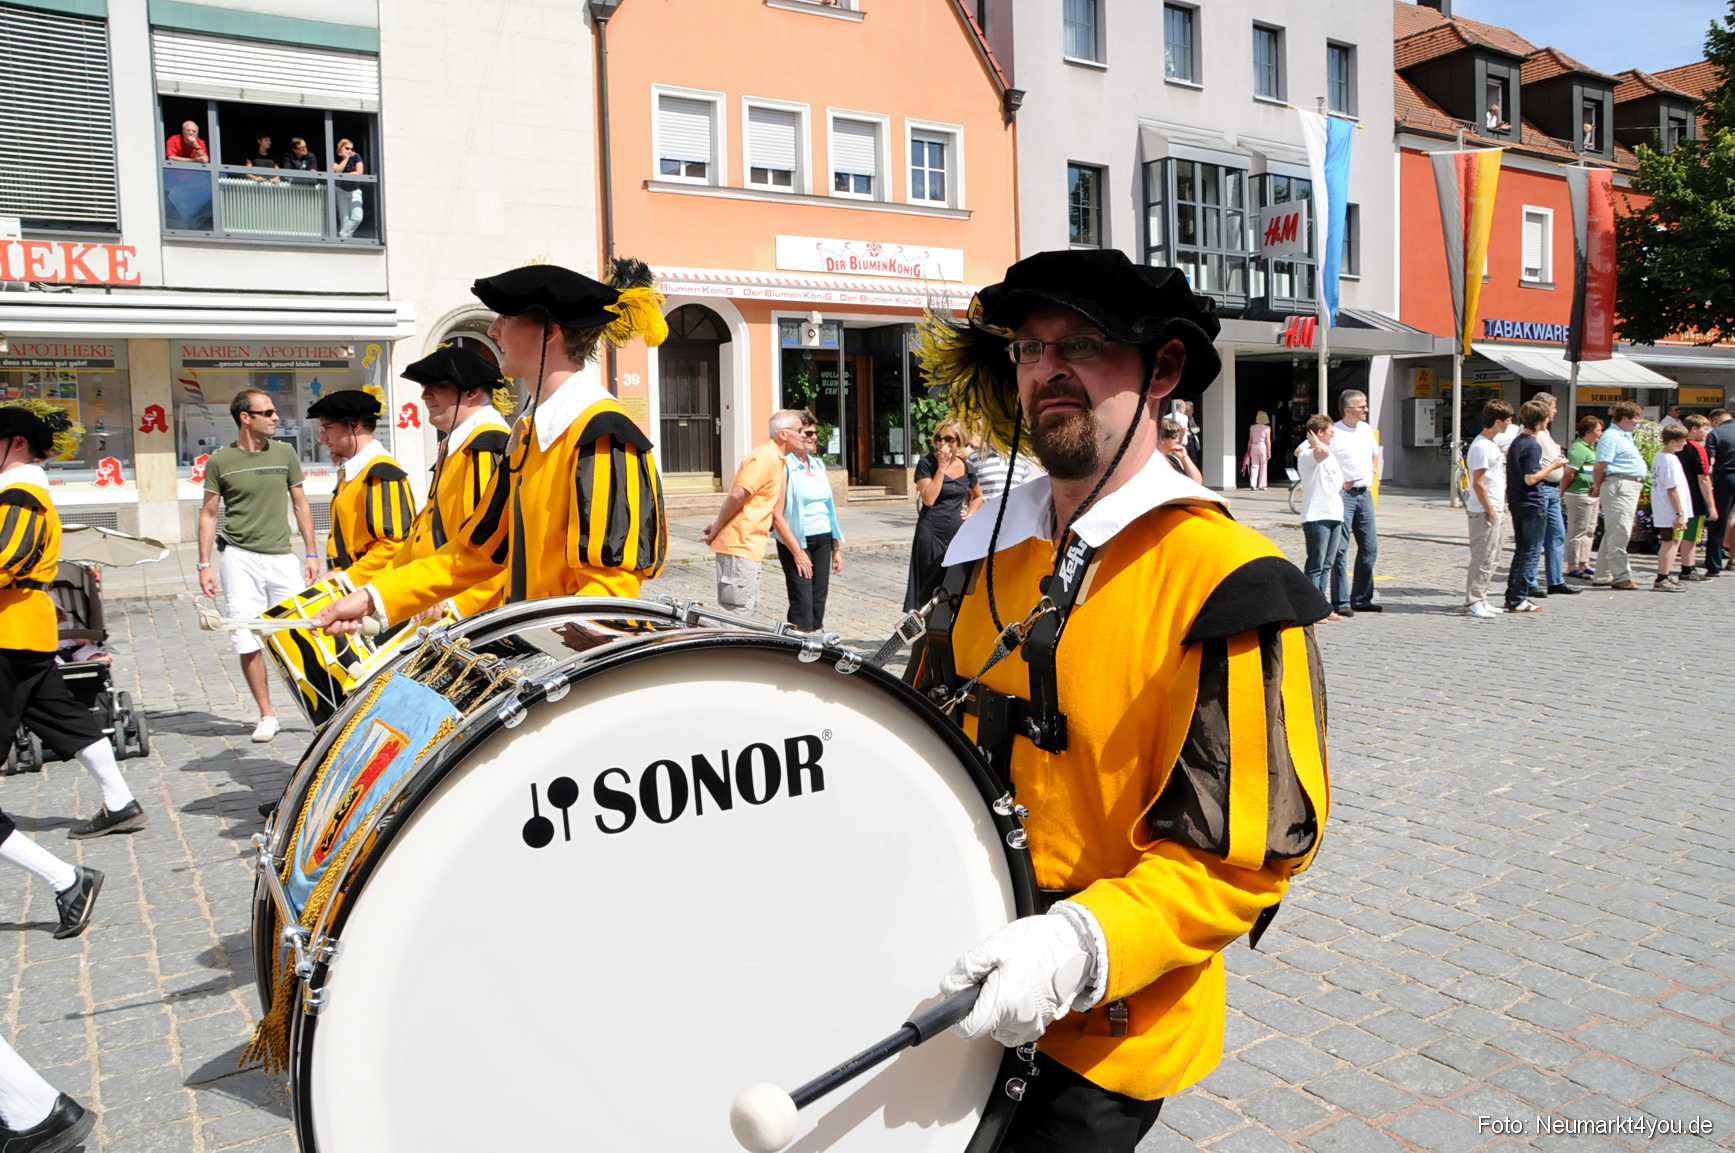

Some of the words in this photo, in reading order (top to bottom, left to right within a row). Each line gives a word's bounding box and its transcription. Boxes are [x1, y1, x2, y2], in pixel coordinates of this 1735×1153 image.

[1264, 212, 1299, 246] H&M
[826, 257, 846, 272] DER
[660, 284, 700, 293] Blumen
[744, 288, 763, 297] Der
[765, 290, 802, 299] Blumen
[840, 293, 858, 302] Der
[860, 295, 894, 304] Blumen
[948, 300, 969, 308] Blum
[1284, 315, 1316, 349] H&M
[7, 343, 116, 358] APOTHEKE
[182, 345, 250, 358] MARIEN
[258, 346, 340, 358] APOTHEK
[55, 360, 68, 368] gut
[623, 373, 640, 386] 39
[821, 371, 852, 379] HOLLD-
[822, 379, 851, 387] BLUMN-
[825, 387, 849, 396] CENR
[593, 734, 825, 834] SONOR
